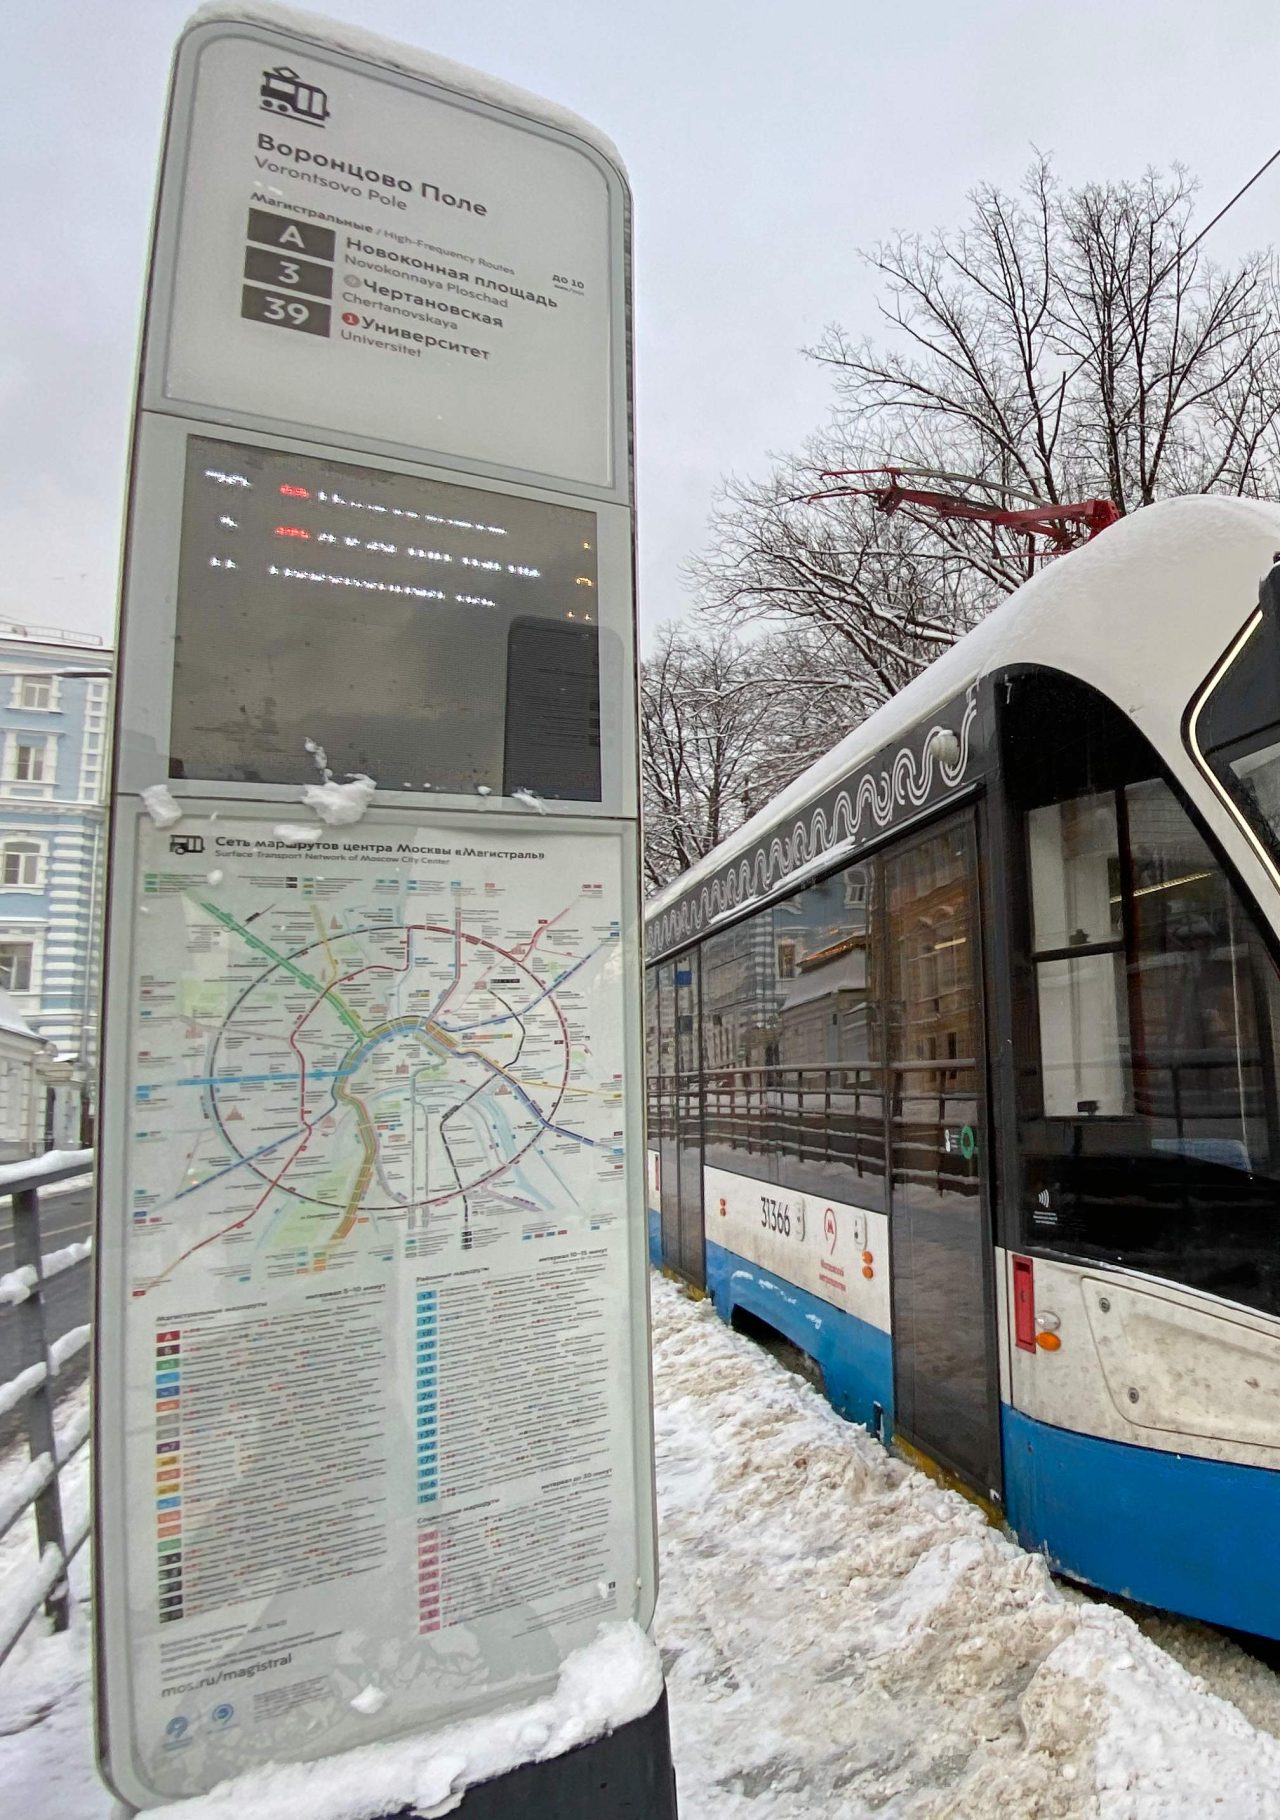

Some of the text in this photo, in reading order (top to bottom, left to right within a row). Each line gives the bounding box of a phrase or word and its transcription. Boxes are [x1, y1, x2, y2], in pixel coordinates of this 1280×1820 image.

[254, 154, 408, 211] Vorontsovo Pole
[257, 132, 488, 217] Воронцово Поле
[250, 191, 374, 234] Магистральные
[384, 229, 476, 265] High-Frequency
[478, 257, 516, 276] Routes
[277, 260, 301, 285] 3
[344, 253, 444, 291] Novokonnaya
[446, 281, 509, 309] Ploschad
[346, 236, 558, 308] Новоконная площадь
[552, 273, 569, 286] до
[571, 278, 585, 290] 10
[263, 295, 310, 326] 39
[341, 290, 458, 331] Chertanovskaya
[363, 277, 504, 329] Чертановская
[340, 328, 422, 358] Universitet
[361, 315, 492, 361] Университет
[215, 835, 251, 848] Сеть
[343, 842, 393, 854] центра
[396, 843, 451, 856] Москвы
[454, 847, 545, 861] «Магистраль»
[215, 850, 451, 866] Surface Transport Network of Moscow City Center
[760, 1195, 791, 1238] 31366
[160, 1652, 293, 1699] mos.ru/magistral
